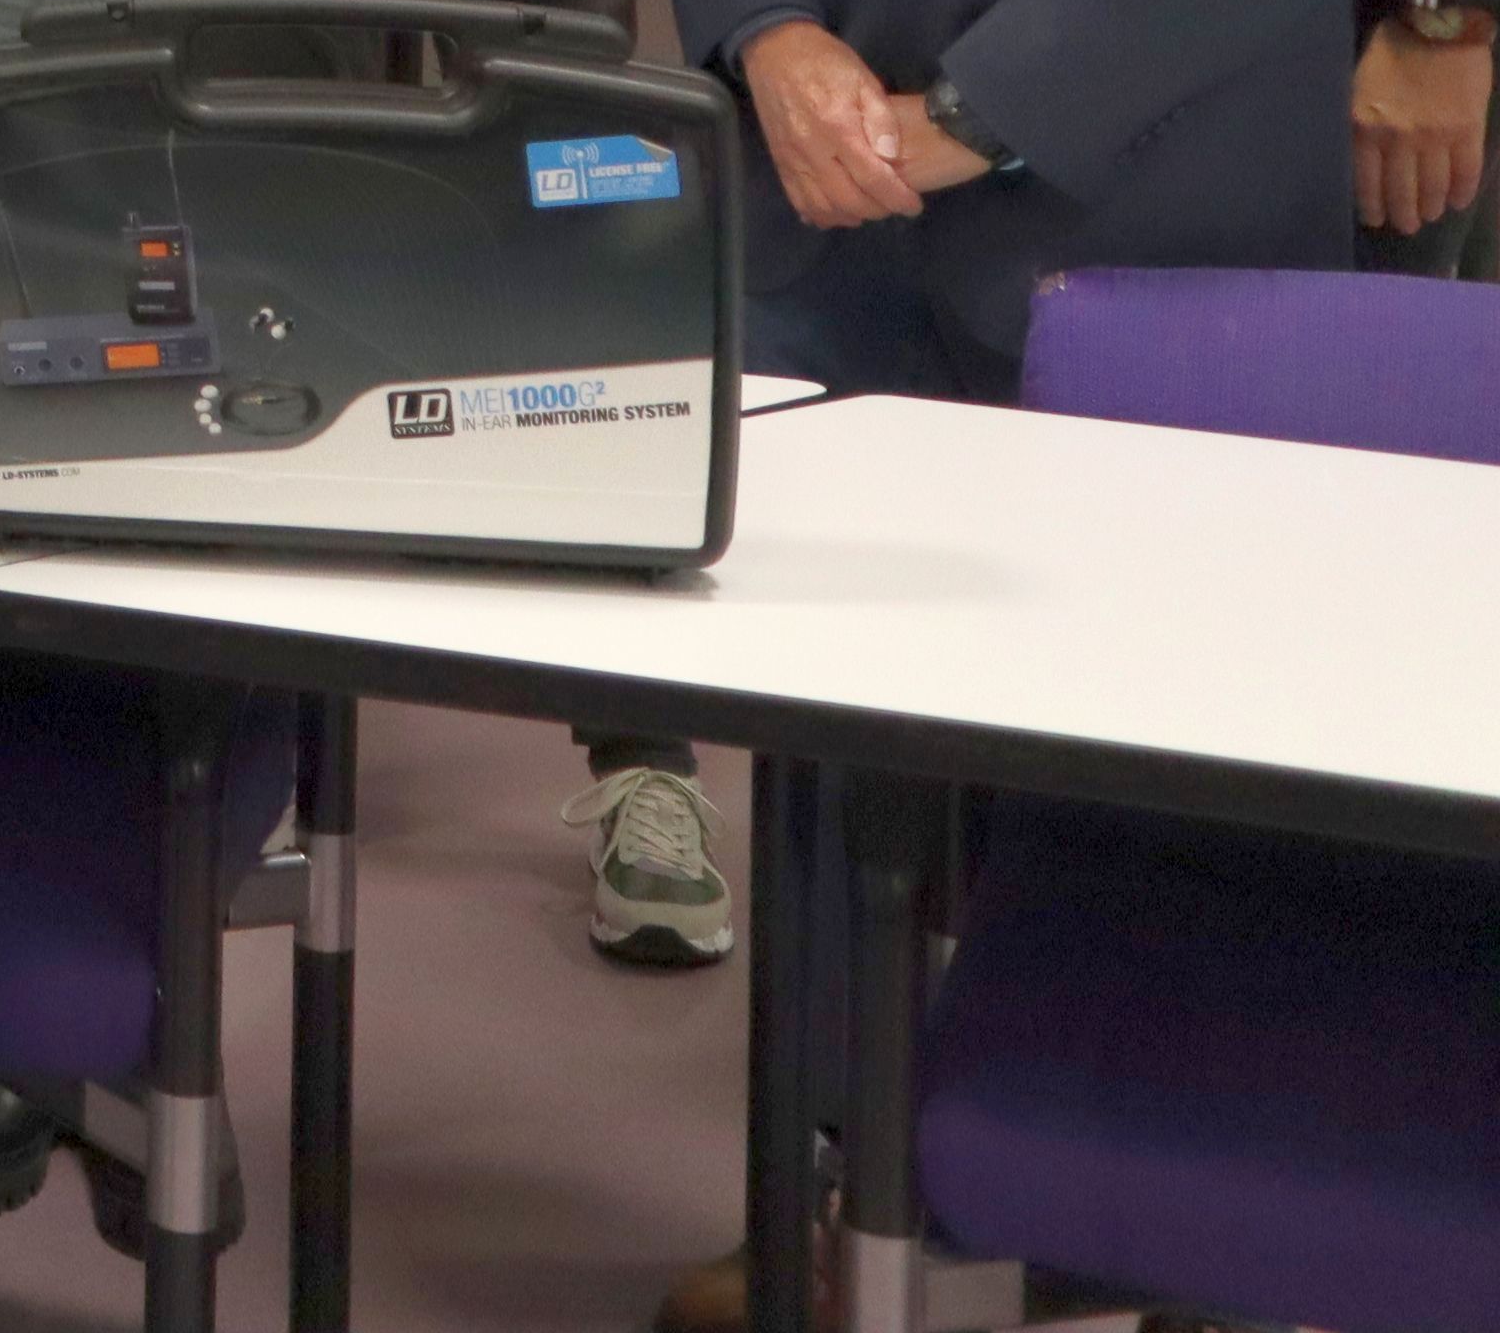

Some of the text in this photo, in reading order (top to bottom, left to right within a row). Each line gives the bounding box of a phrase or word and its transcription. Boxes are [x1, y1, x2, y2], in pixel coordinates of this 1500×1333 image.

[541, 172, 574, 192] LD
[393, 392, 449, 425] LD
[461, 401, 691, 432] IN-EAR MONITORING SYSTEM
